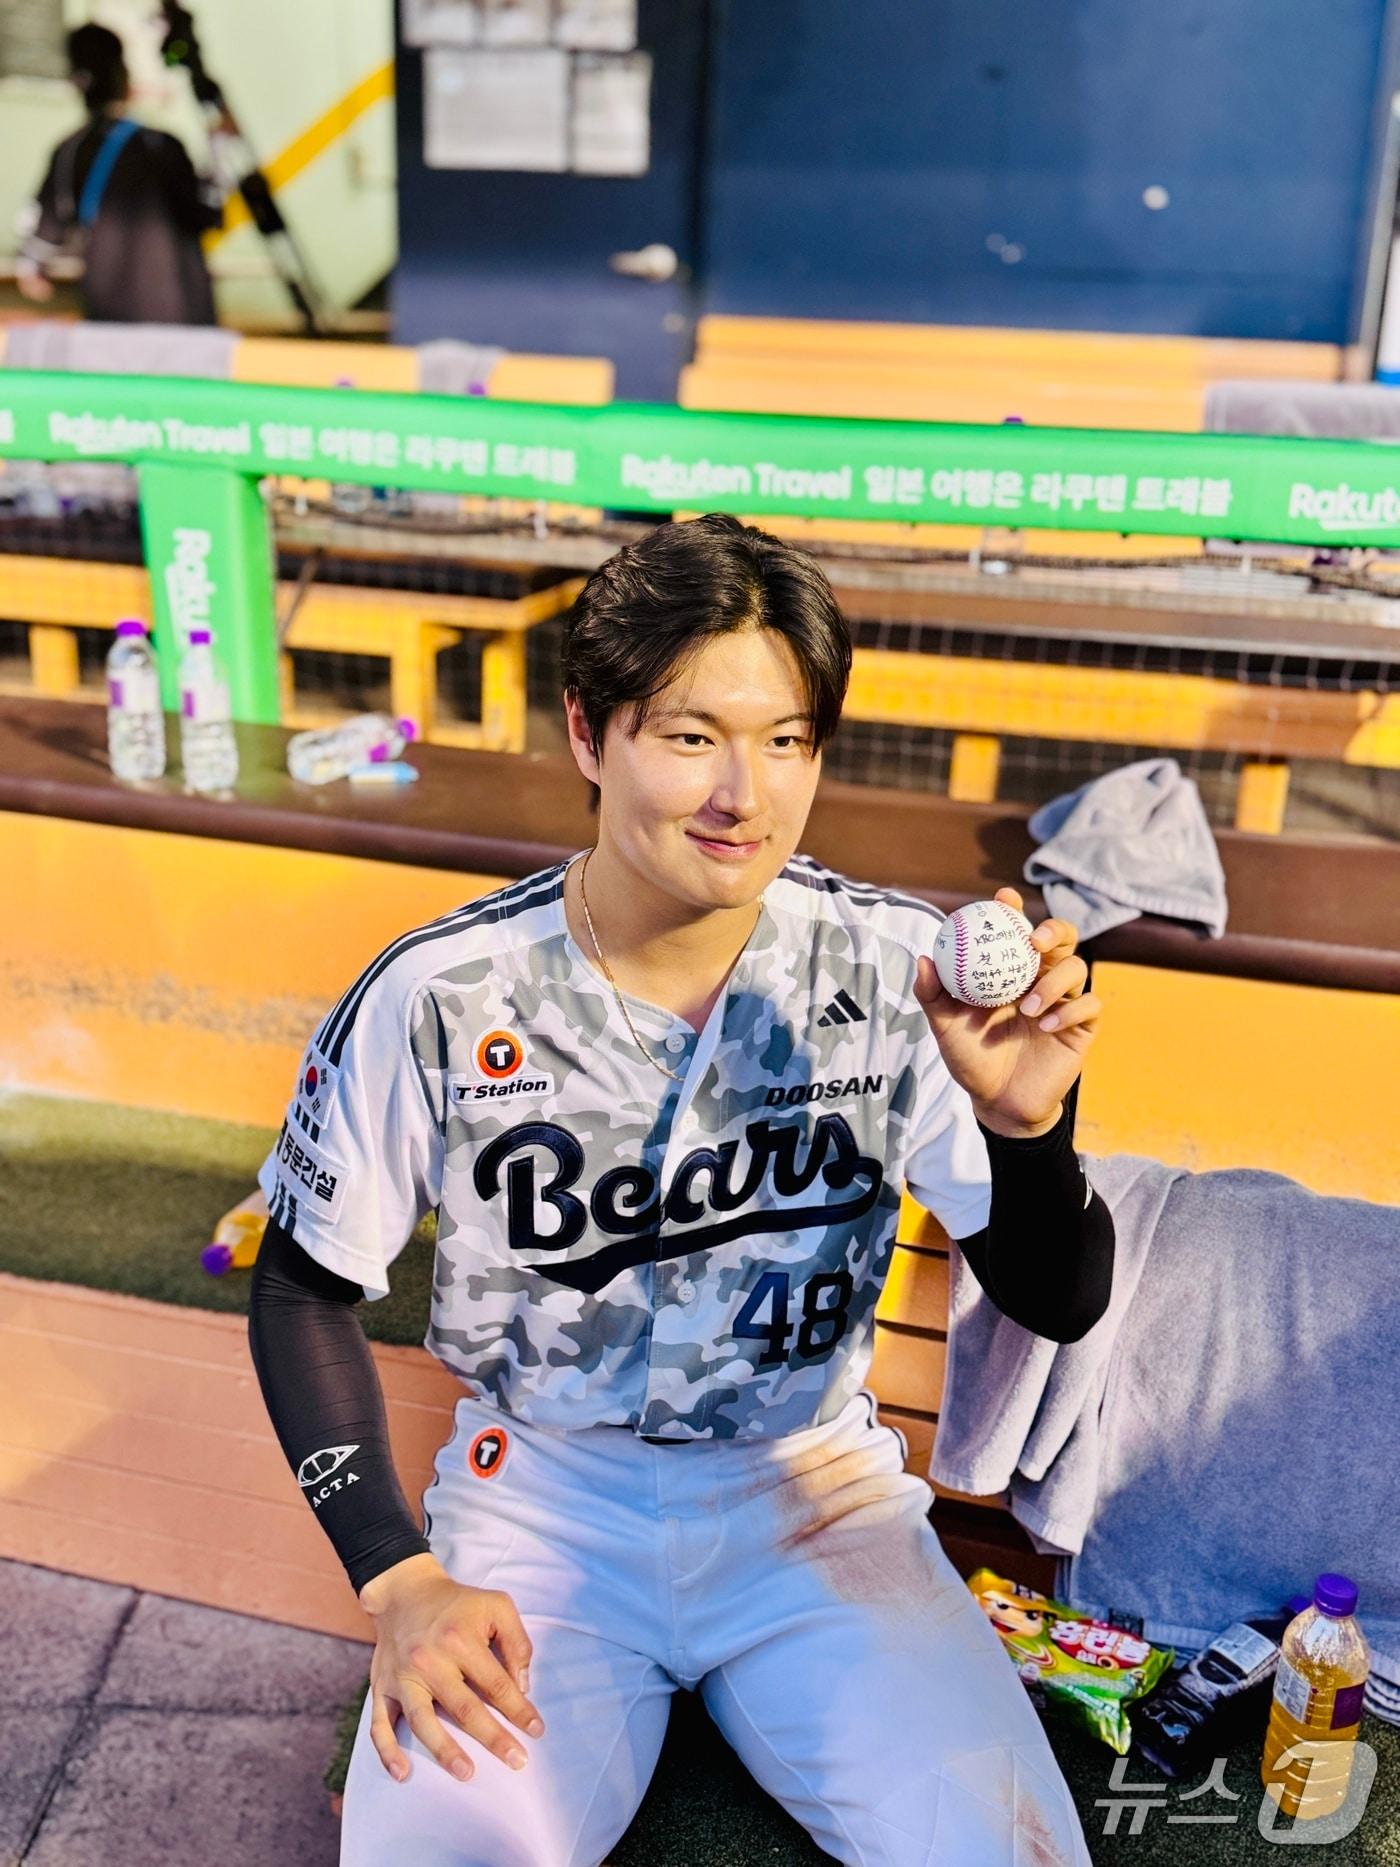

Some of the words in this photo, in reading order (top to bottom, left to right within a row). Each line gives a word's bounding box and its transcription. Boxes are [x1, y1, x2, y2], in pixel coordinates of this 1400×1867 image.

[49, 411, 163, 454] Rakuten
[162, 418, 250, 454] Travel
[258, 422, 312, 460] 일본
[621, 453, 751, 499] Rakuten
[754, 462, 853, 500] Travel
[863, 465, 925, 505] 일본
[931, 468, 1024, 509] 여행은
[1030, 472, 1128, 513] 라쿠텐
[1132, 477, 1232, 517] 트래블
[488, 1043, 511, 1067] T
[456, 1078, 548, 1099] T'Station
[765, 1074, 883, 1107] DOOSAN
[473, 1112, 885, 1256] Bears
[731, 1270, 853, 1366] 48
[311, 1471, 362, 1508] ACTA
